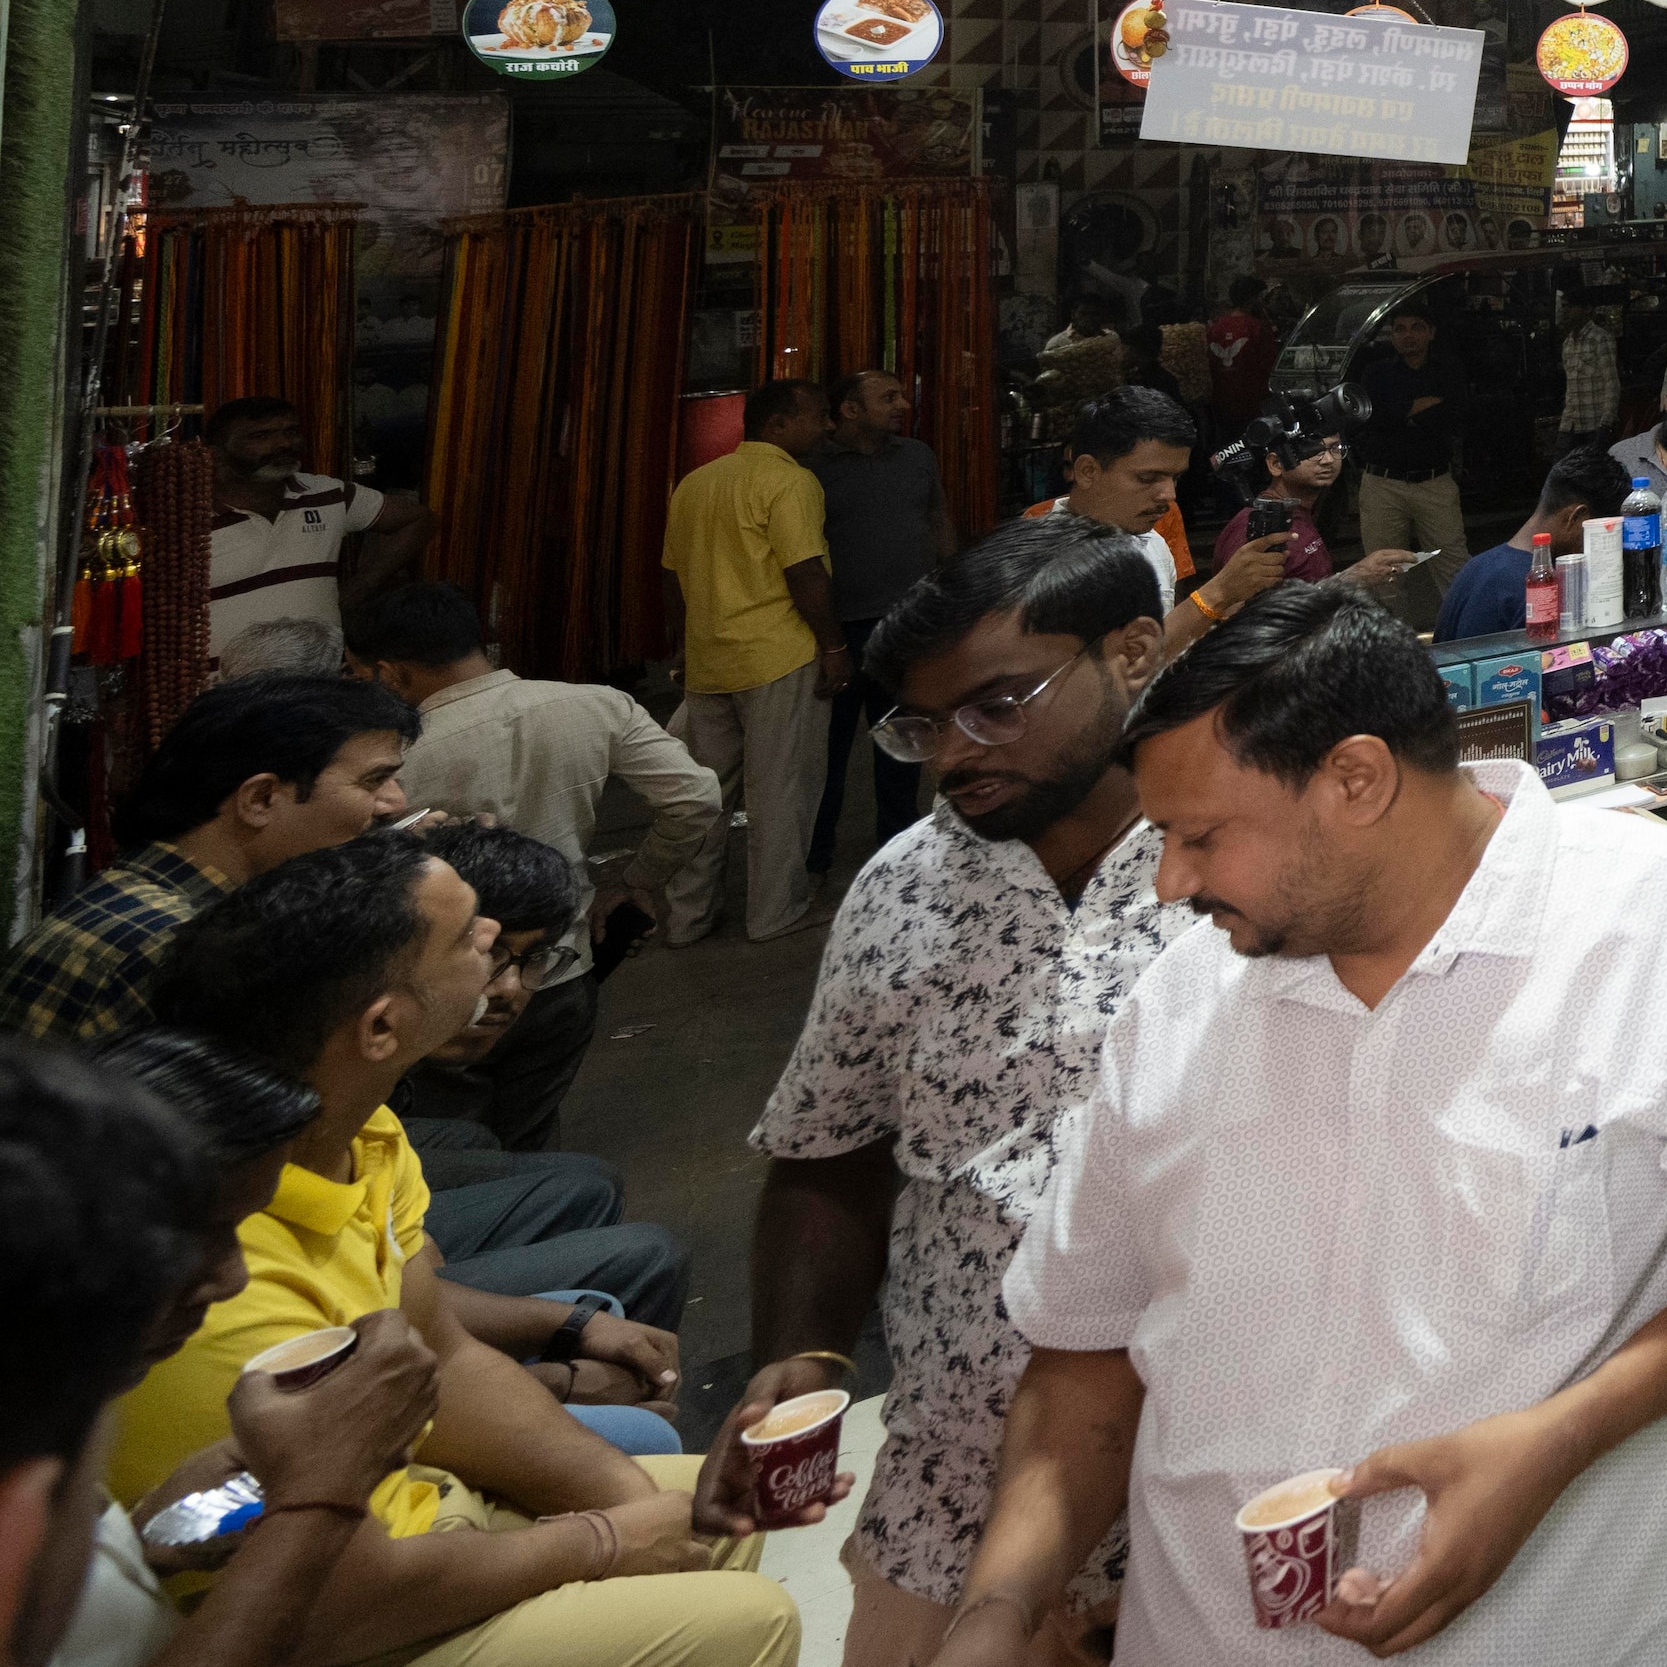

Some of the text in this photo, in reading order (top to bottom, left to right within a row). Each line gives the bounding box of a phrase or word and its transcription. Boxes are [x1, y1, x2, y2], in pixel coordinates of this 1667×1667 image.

[505, 57, 580, 74] राज कचोरी
[850, 59, 908, 76] पाव भाजी
[1585, 80, 1602, 91] भोग
[1566, 747, 1596, 768] Milk
